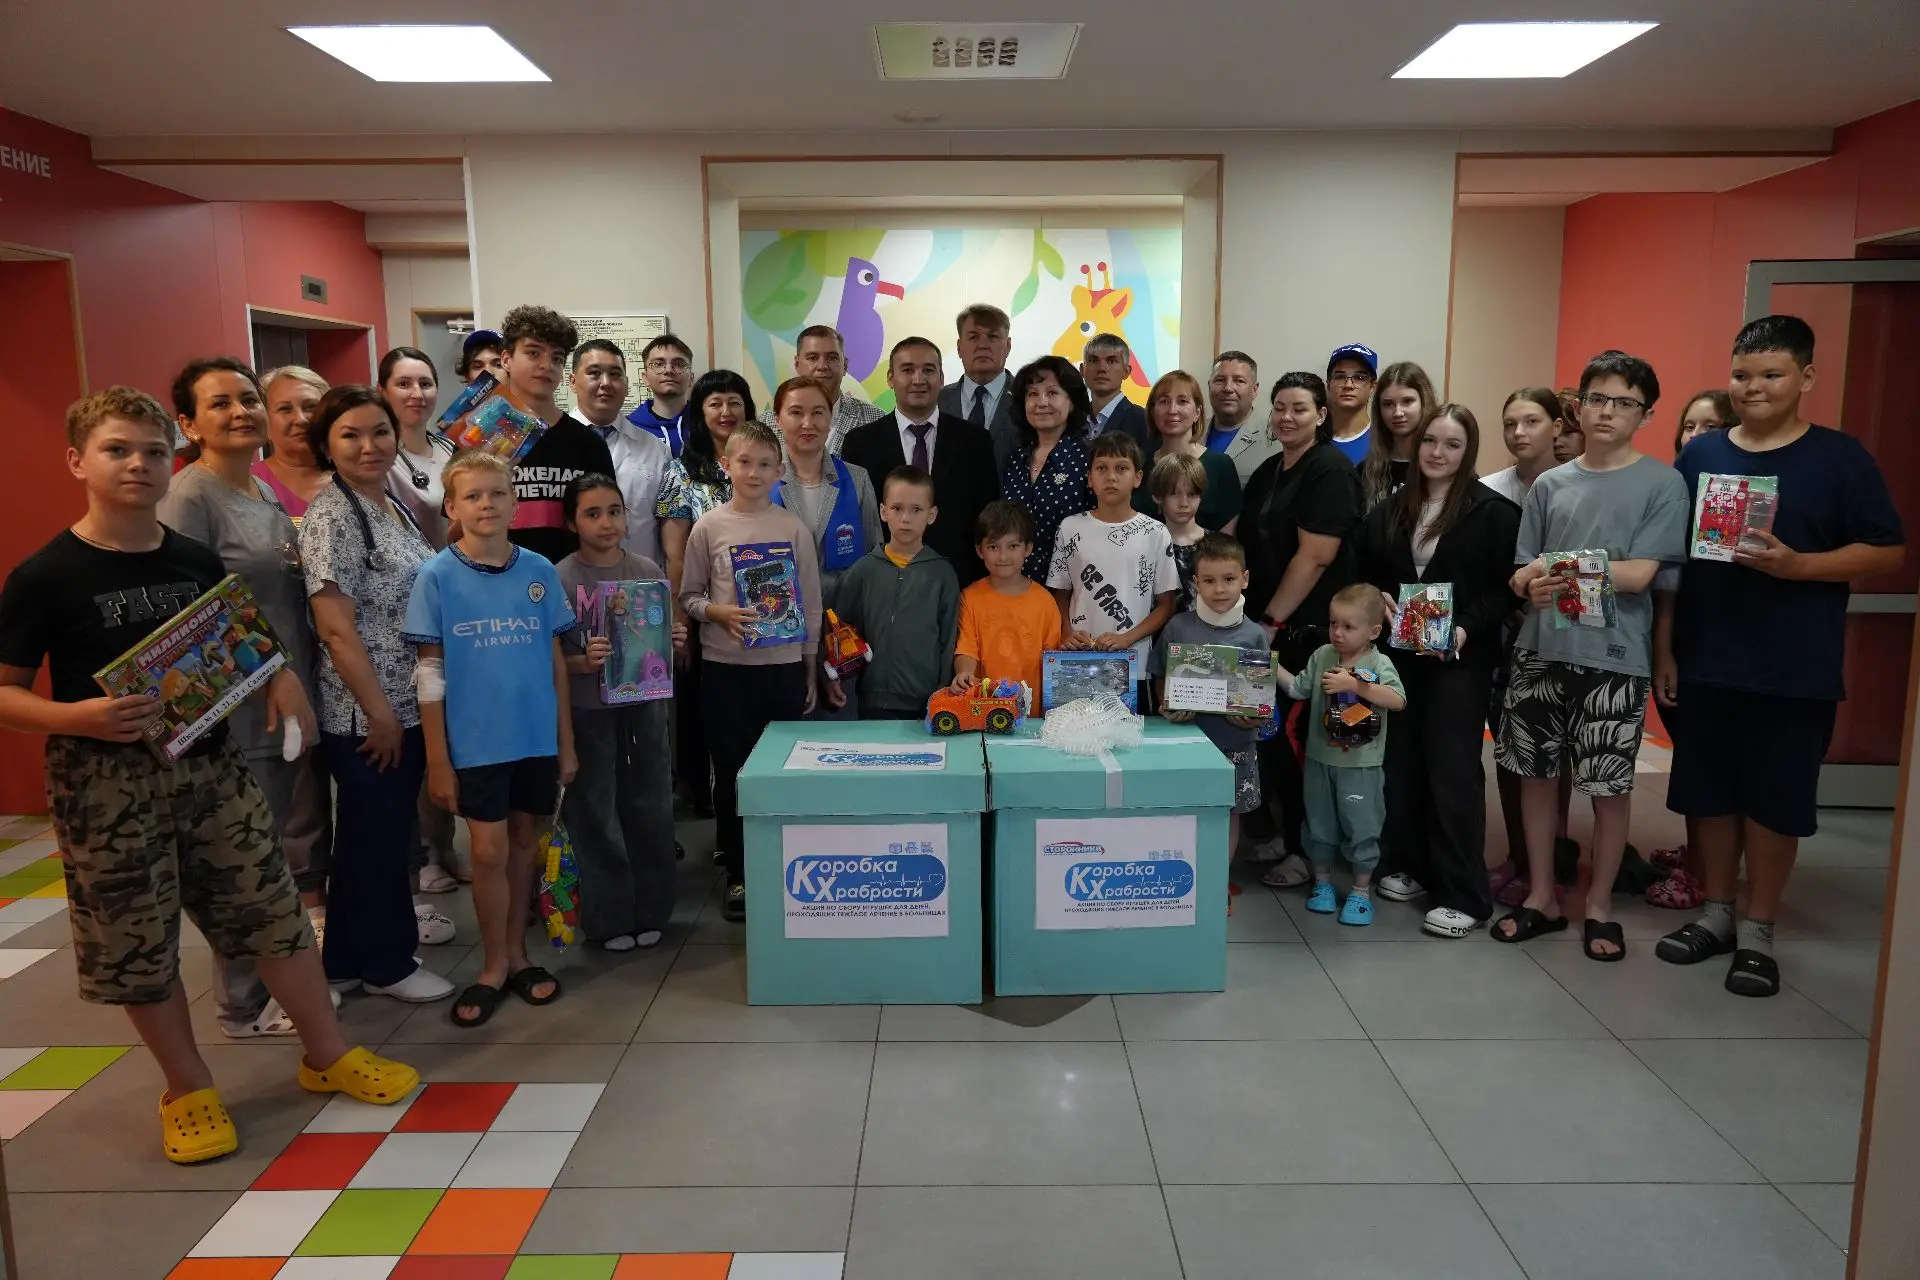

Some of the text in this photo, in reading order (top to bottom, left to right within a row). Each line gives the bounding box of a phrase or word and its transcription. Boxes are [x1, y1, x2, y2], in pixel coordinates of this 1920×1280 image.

[1080, 563, 1134, 632] BE FIRST
[138, 600, 222, 667] МИЛЛИОНЕР
[452, 616, 541, 637] ETIHAD
[473, 634, 533, 649] AIRWAYS
[791, 857, 898, 895] Коробка
[813, 876, 924, 902] Храбрости
[1069, 862, 1156, 895] Коробка
[1087, 879, 1176, 900] Храбрости
[1450, 926, 1474, 935] croc
